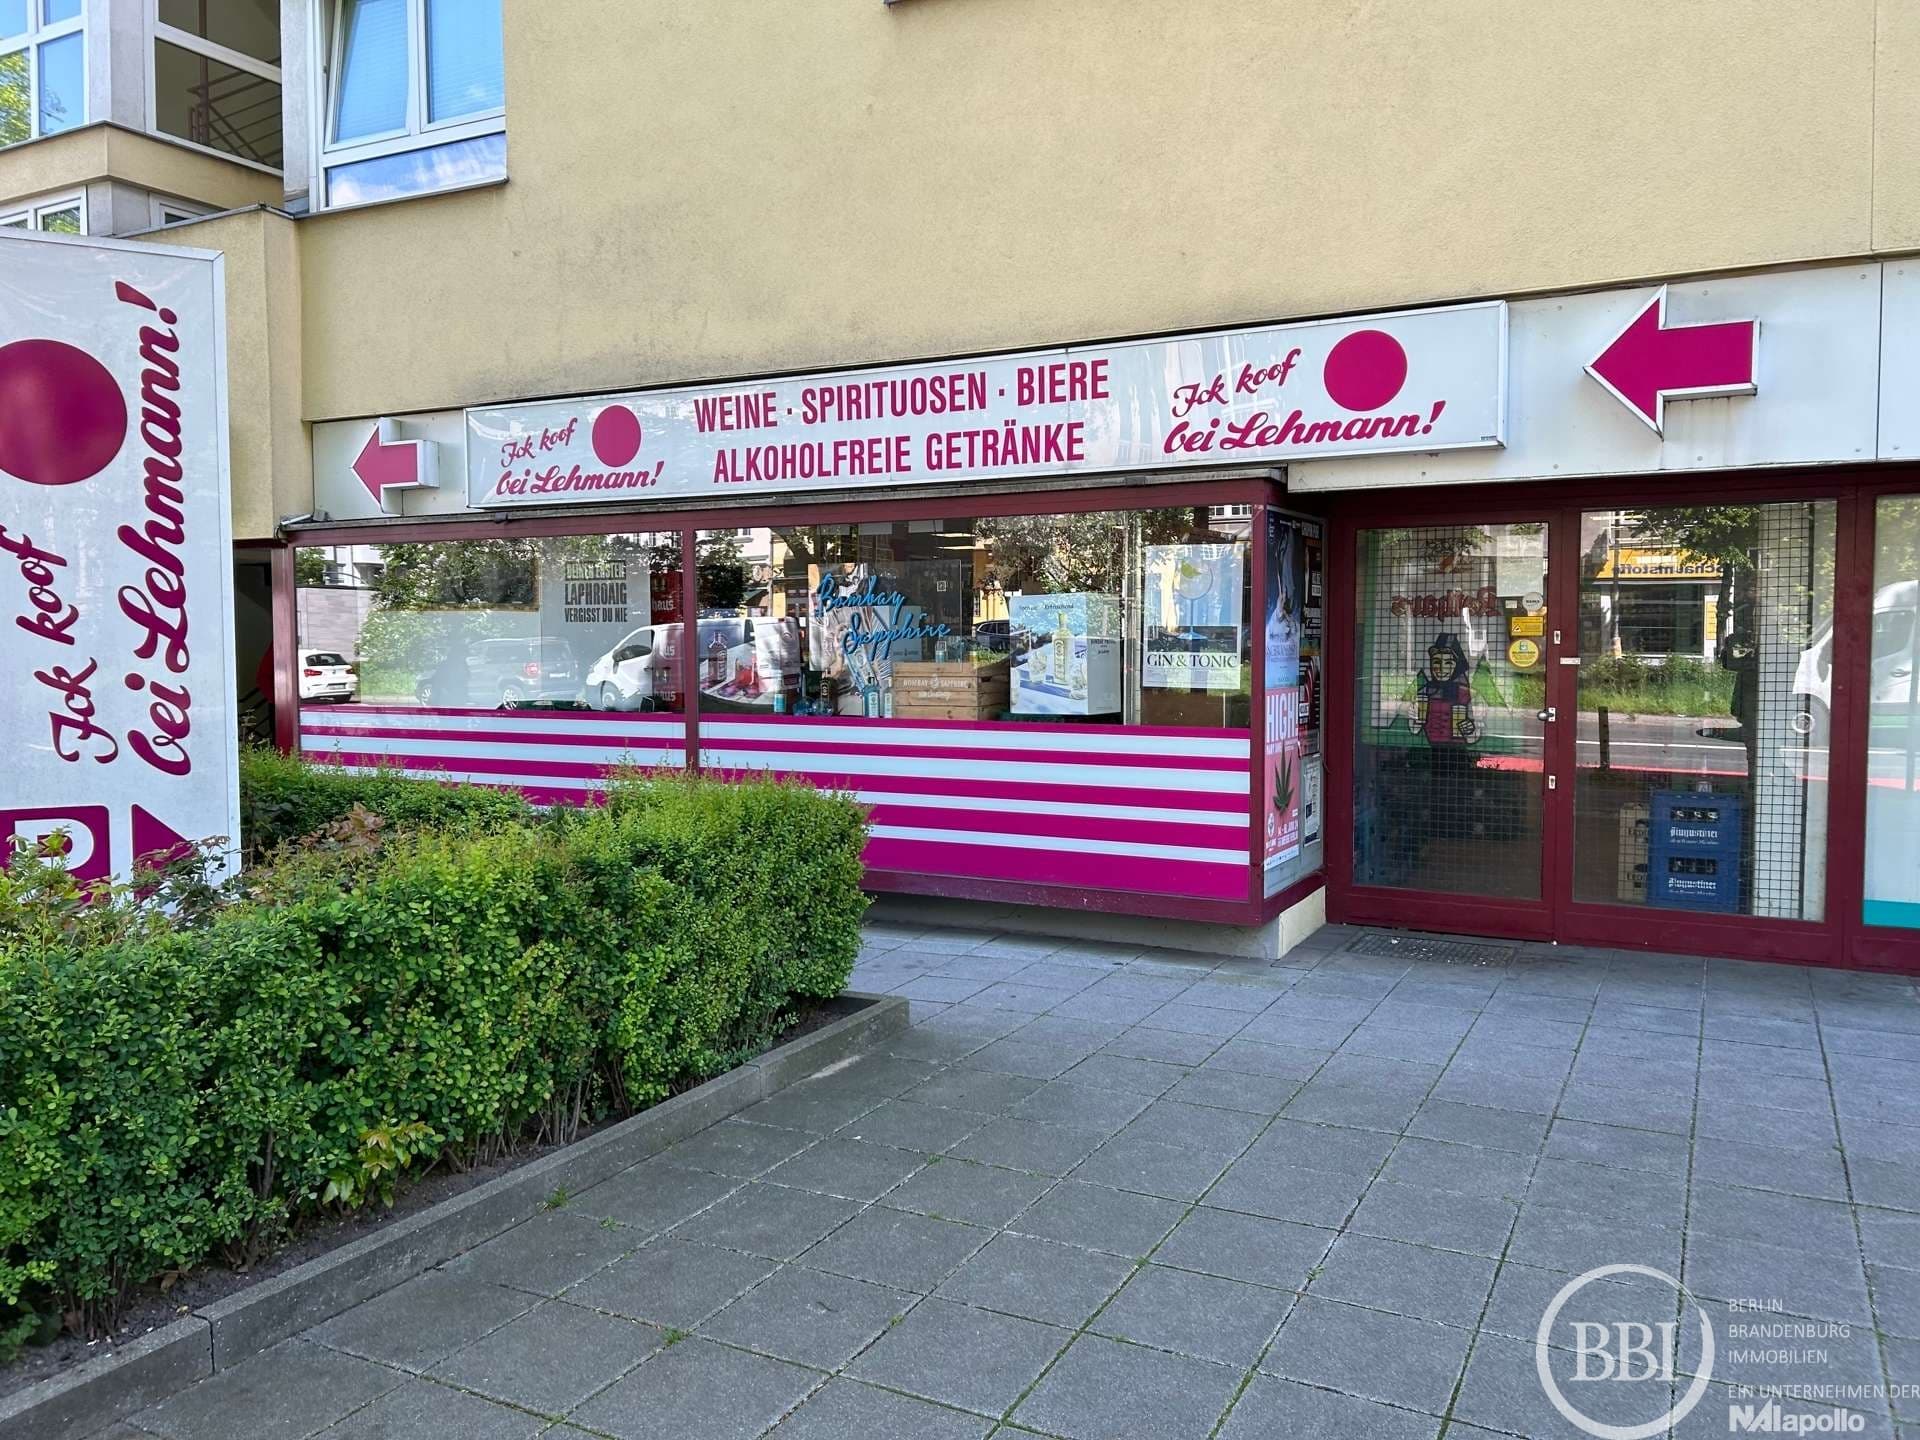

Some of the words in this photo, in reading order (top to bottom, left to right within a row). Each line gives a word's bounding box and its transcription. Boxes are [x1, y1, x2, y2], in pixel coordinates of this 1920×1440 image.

[694, 392, 777, 433] WEINE
[802, 371, 986, 425] SPIRITUOSEN
[1017, 359, 1109, 407] BIERE
[1235, 348, 1301, 394] koof
[539, 417, 578, 451] koof
[714, 435, 911, 483] ALKOHOLFREIE
[926, 419, 1084, 471] GETRÄNKE
[1164, 418, 1220, 453] bei
[1220, 400, 1446, 449] Lehmann!
[114, 280, 191, 673] Lehmann!
[496, 470, 527, 496] bei
[530, 461, 664, 494] Lehmann!
[0, 524, 79, 646] koof
[565, 582, 627, 605] LAPHROAIG
[814, 571, 904, 624] Bombay
[565, 607, 600, 622] VERGISST
[602, 607, 613, 622] DU
[615, 607, 627, 622] NIE
[842, 612, 952, 661] Sapphire
[1147, 653, 1173, 667] GIN
[1176, 654, 1187, 667] &
[1189, 654, 1237, 668] TONIC
[127, 673, 192, 776] bei
